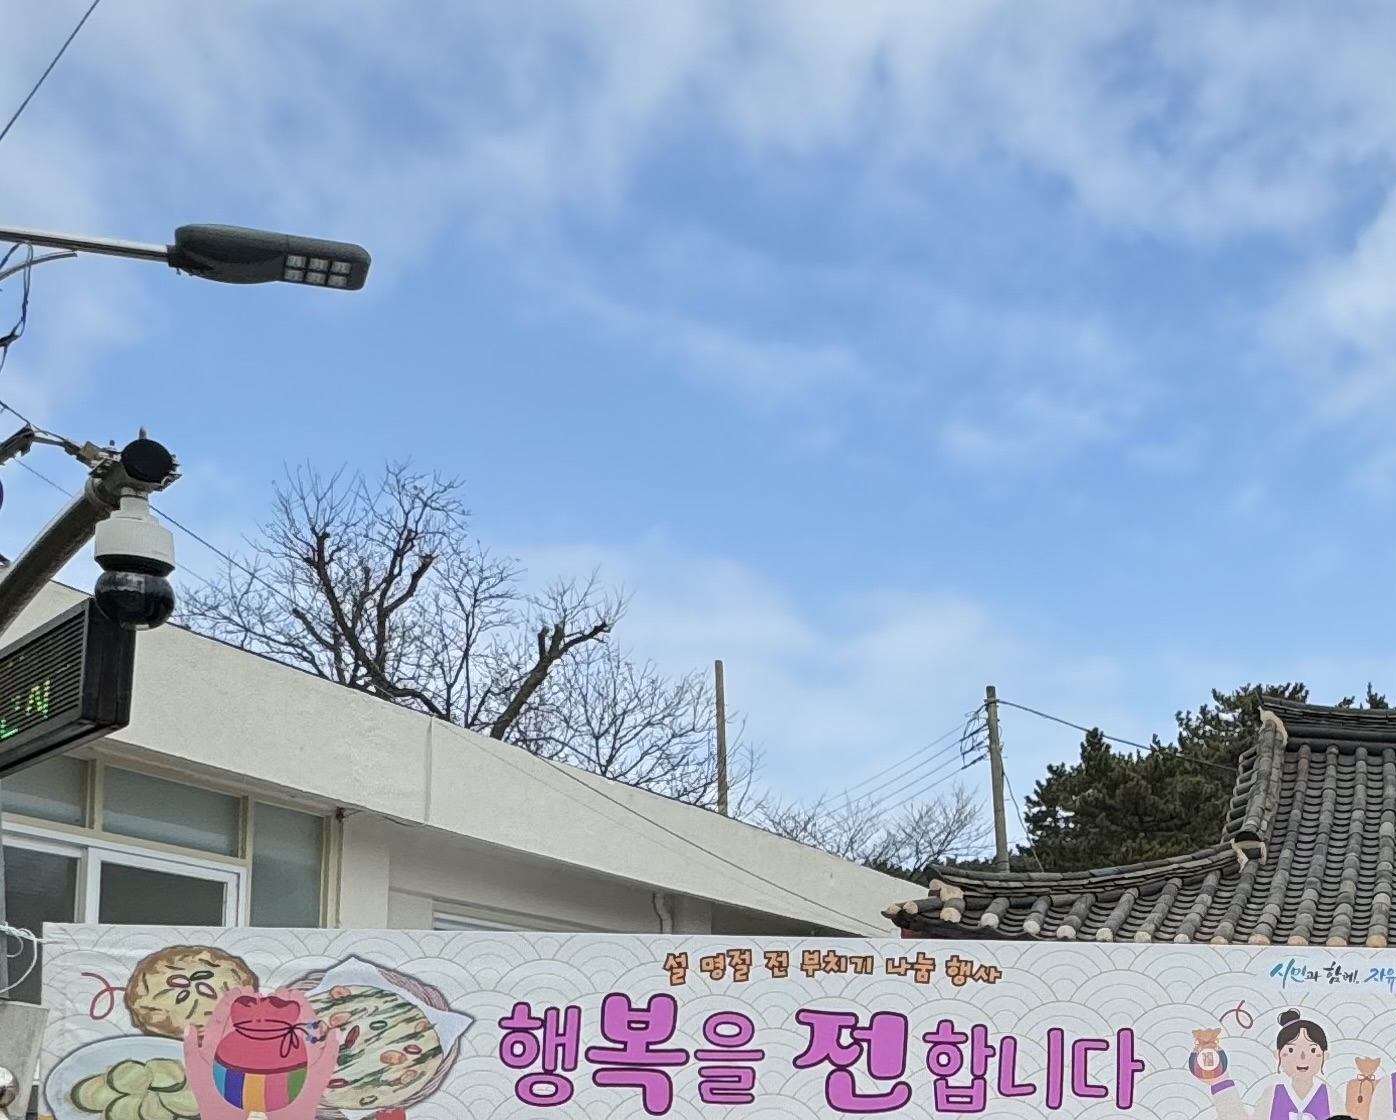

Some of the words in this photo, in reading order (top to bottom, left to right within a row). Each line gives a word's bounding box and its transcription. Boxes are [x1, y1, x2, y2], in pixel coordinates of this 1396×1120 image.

[663, 952, 689, 986] 설
[700, 949, 752, 982] 명절
[764, 950, 789, 978] 전
[800, 950, 874, 977] 부치기
[885, 952, 936, 984] 나눔
[945, 955, 1002, 987] 행사
[1270, 958, 1322, 989] 시민과
[498, 992, 765, 1116] 행복을
[792, 1008, 1145, 1114] 전합니다
